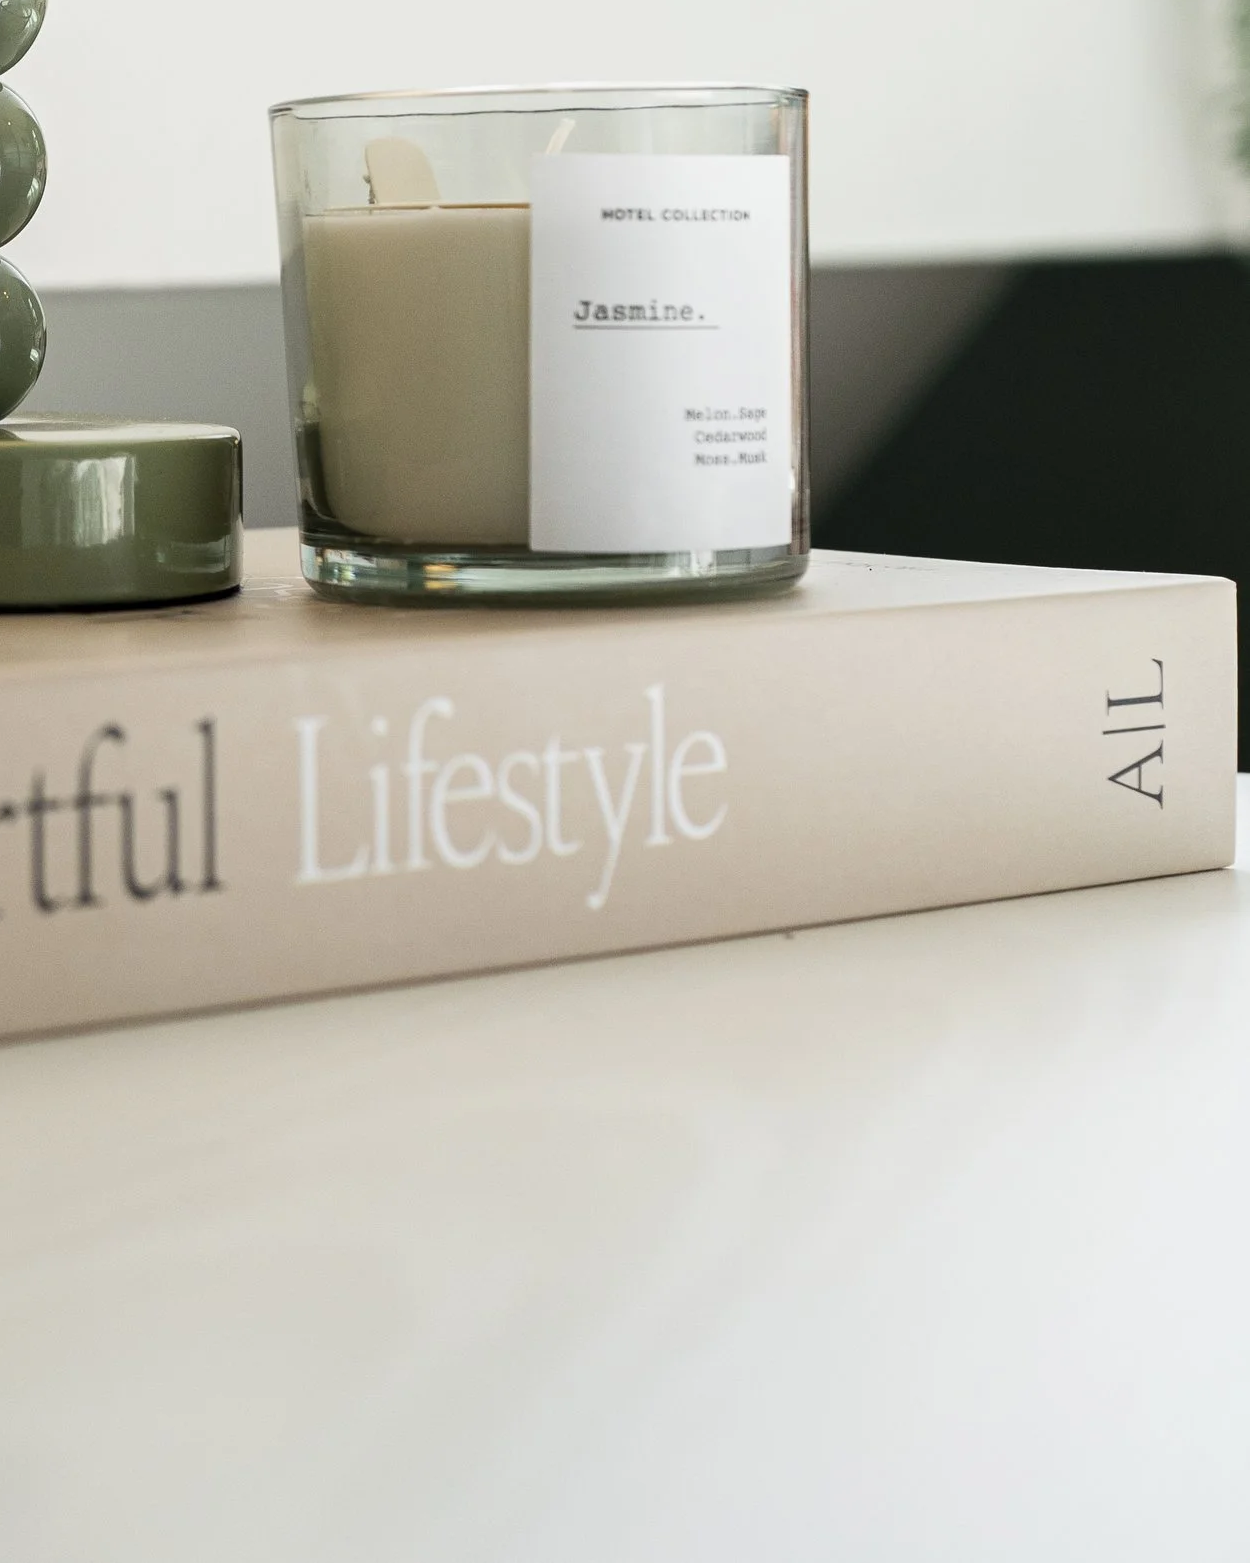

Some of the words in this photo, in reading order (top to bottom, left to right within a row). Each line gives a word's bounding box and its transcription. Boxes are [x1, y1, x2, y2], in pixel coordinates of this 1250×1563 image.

[601, 208, 655, 221] HOTEL
[661, 208, 751, 222] COLLECTION
[574, 299, 705, 321] Jasmine.
[693, 427, 768, 444] Cedarwood
[290, 683, 730, 911] Lifestyle
